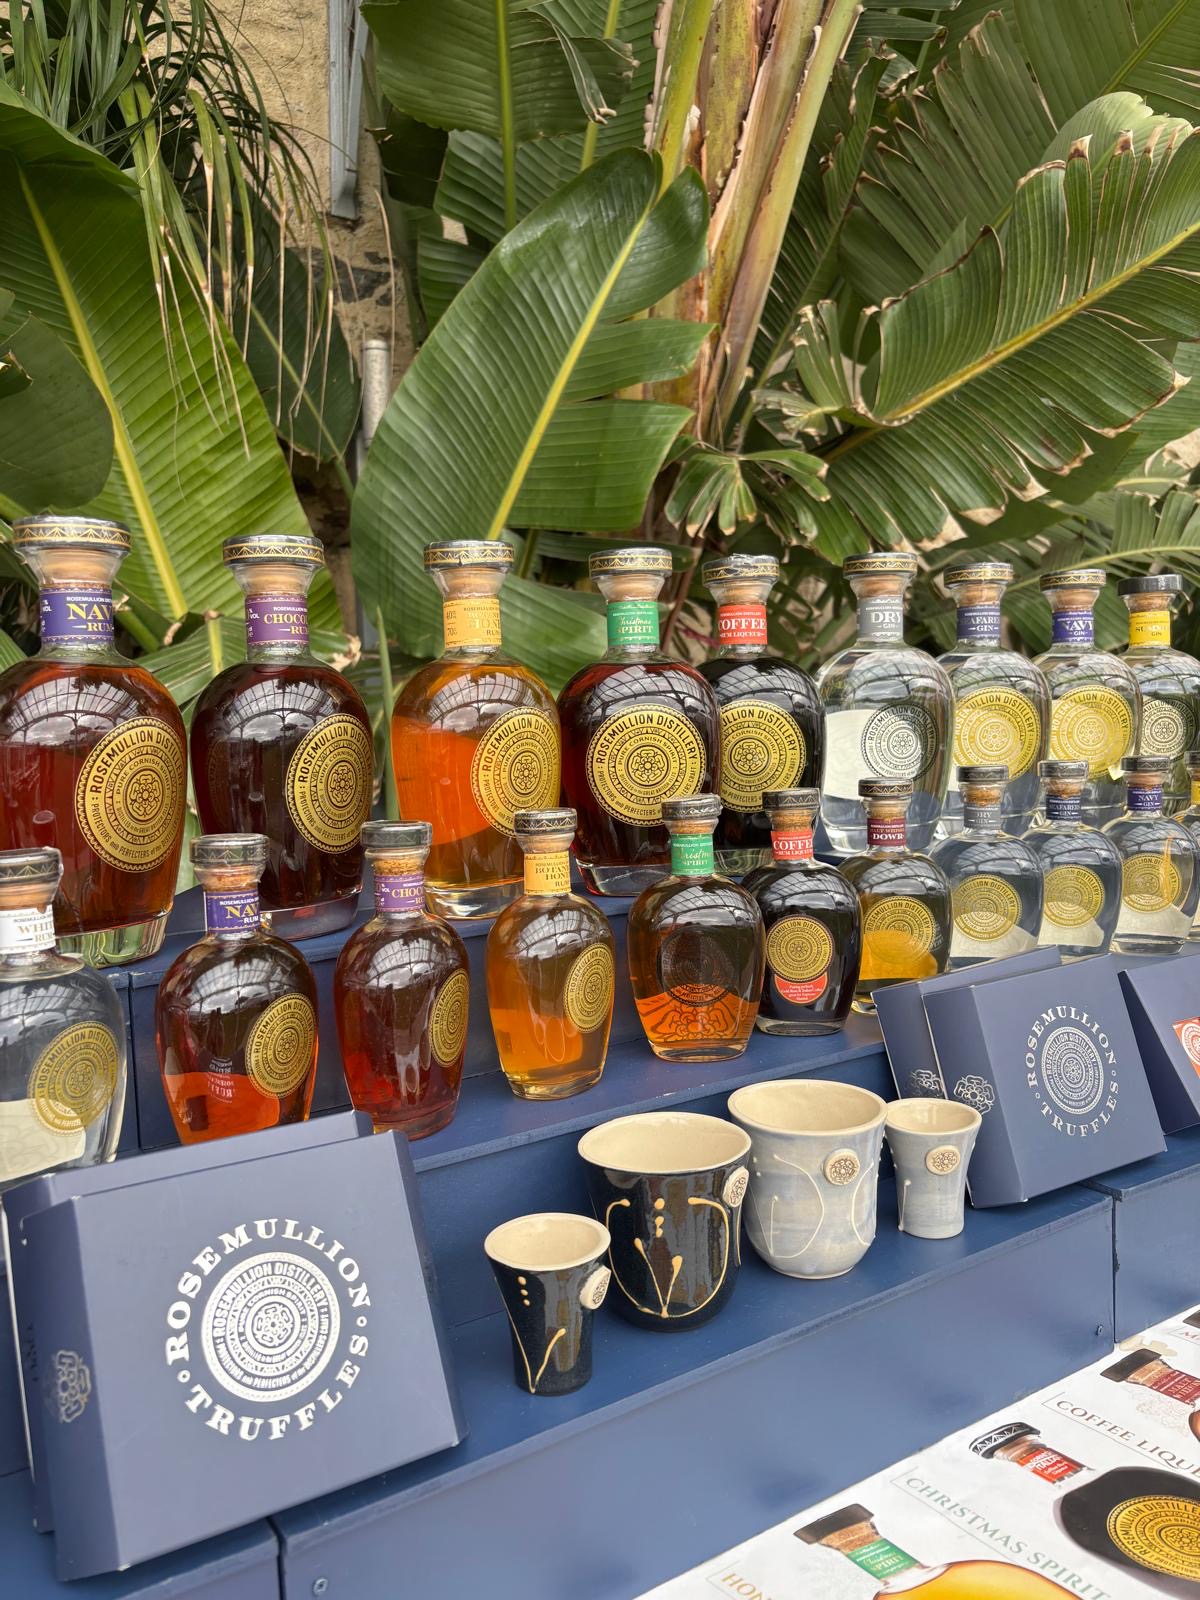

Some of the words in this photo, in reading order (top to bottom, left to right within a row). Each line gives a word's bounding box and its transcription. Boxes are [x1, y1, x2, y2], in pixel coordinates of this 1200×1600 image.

[976, 624, 994, 632] GIN
[1062, 620, 1093, 631] NAVY
[757, 709, 798, 752] DISTILLERY
[867, 706, 909, 741] ROSEMULLION
[910, 706, 936, 740] DISTILLERY
[1003, 695, 1035, 733] DISTILLERY
[1099, 693, 1129, 729] DISTILLERY
[298, 725, 348, 784] ROSEMULLION
[482, 717, 533, 772] ROSEMULLION
[596, 713, 654, 764] ROSEMULLION
[656, 714, 698, 760] DISTILLERY
[617, 745, 630, 765] PURE
[629, 735, 663, 746] CORNISH
[663, 740, 677, 764] SPIRIT
[90, 730, 153, 795] ROSEMULLION
[116, 772, 128, 795] PURE
[129, 757, 161, 771] CORNISH
[597, 770, 616, 802] PROTECTORS
[623, 804, 656, 817] PERFECTERS
[91, 803, 112, 845] PROTECTORS
[770, 921, 801, 949] ROSEMULLION
[802, 921, 829, 946] DISTILLERY
[866, 901, 903, 932] ROSEMULLION
[904, 901, 931, 929] DISTILLERY
[253, 1003, 293, 1054] ROSEMULLION
[1025, 1005, 1117, 1089] ROSEMULLION
[37, 1030, 86, 1089] ROSEMULLION
[88, 1029, 115, 1064] DISTILLERY
[1046, 1032, 1069, 1075] ROSEMULLION
[1039, 1081, 1120, 1137] TRUFFLES
[165, 1218, 372, 1367] ROSEMULLION
[212, 1262, 273, 1338] ROSEMULLION
[273, 1262, 329, 1307] DISTILLERY
[185, 1334, 369, 1441] TRUFFLES
[1056, 1400, 1136, 1441] COFFEE
[906, 1477, 1028, 1555] CHRISTMAS
[1026, 1551, 1111, 1600] SPIRIT
[1119, 1507, 1151, 1556] ROSEMULLION
